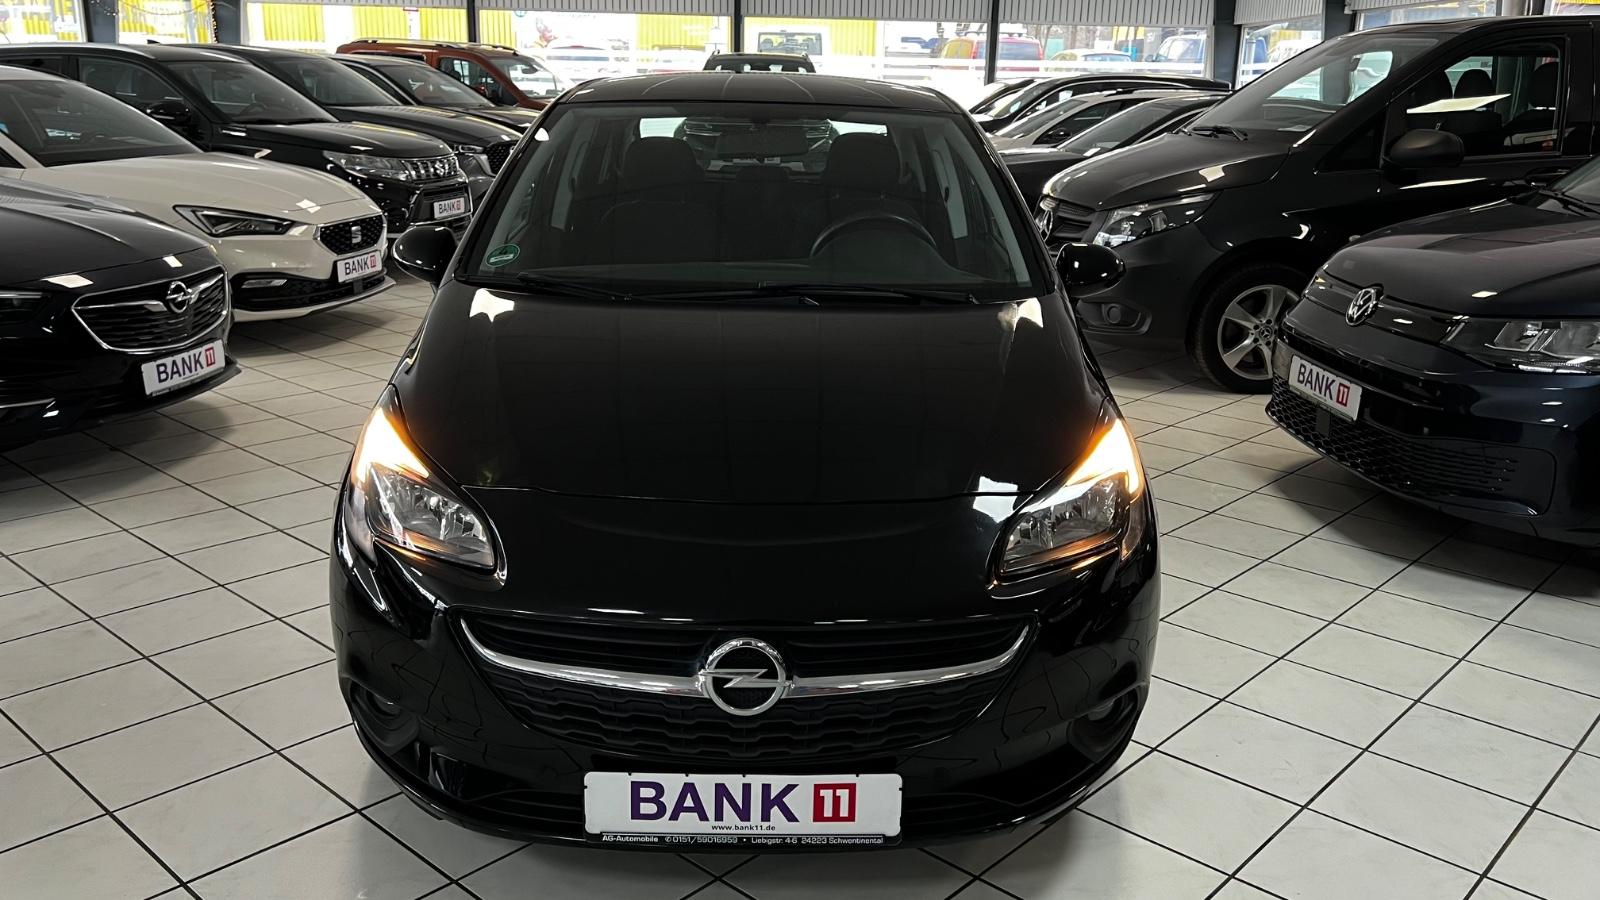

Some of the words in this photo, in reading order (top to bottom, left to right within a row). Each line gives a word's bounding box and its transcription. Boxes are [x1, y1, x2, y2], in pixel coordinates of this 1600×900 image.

[344, 256, 369, 275] BANK
[156, 351, 204, 384] BANK
[1297, 363, 1336, 400] BANK
[1337, 384, 1349, 405] 11
[630, 781, 800, 823] BANK
[817, 787, 853, 819] 11
[602, 835, 659, 843] AG-Automobile
[751, 837, 782, 845] Liebigstr.
[711, 824, 776, 832] www.bank11.de
